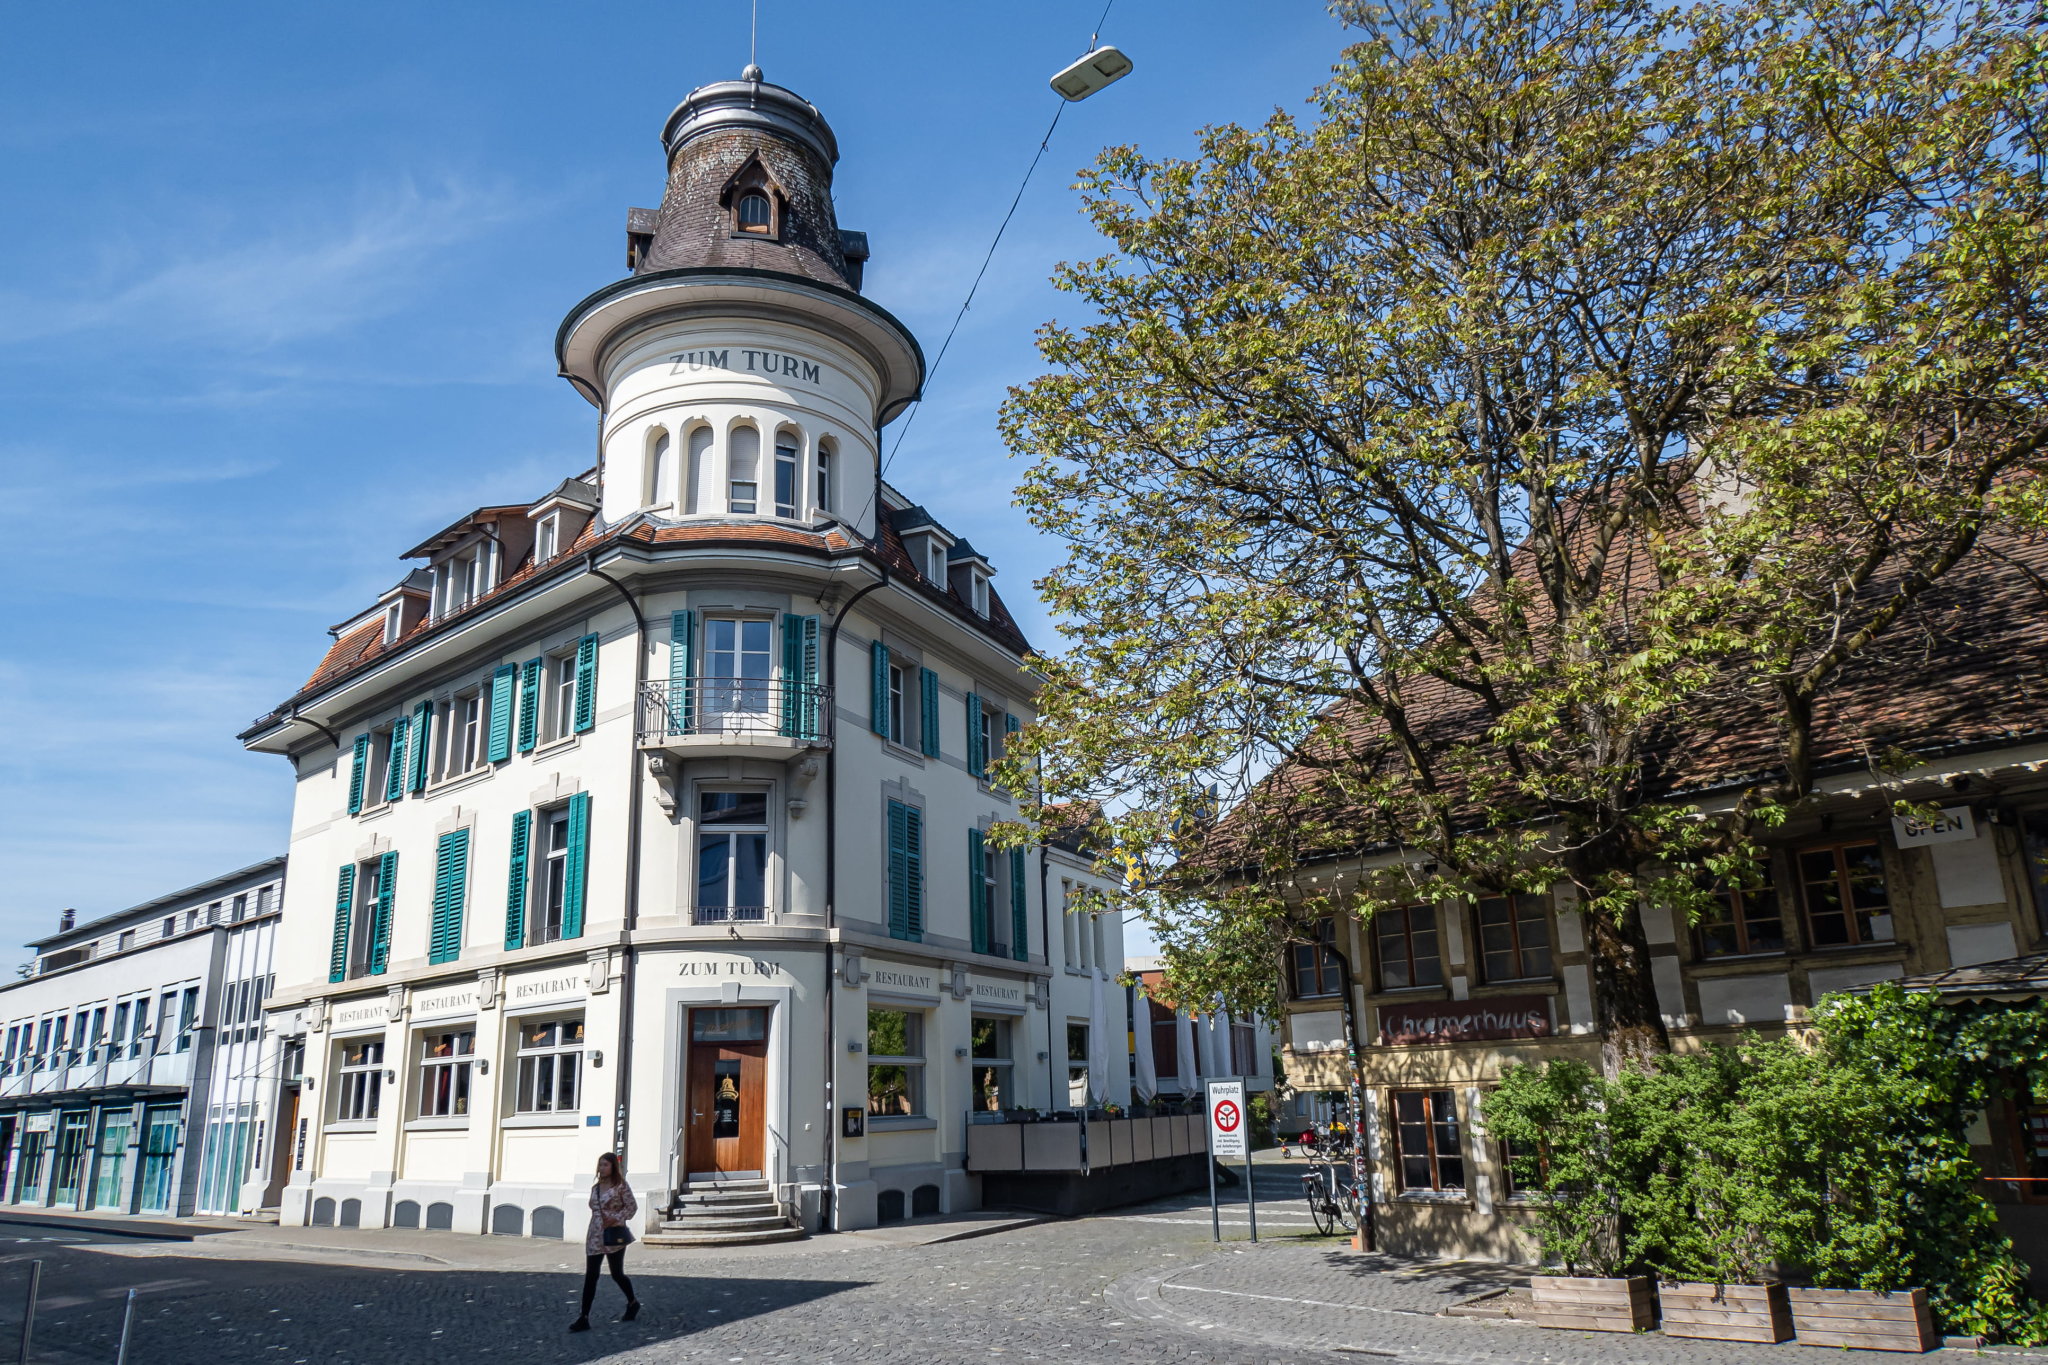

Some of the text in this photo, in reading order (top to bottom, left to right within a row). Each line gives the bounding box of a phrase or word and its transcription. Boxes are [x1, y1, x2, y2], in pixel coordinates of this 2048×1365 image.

[669, 350, 820, 385] ZUM TURM
[679, 962, 781, 976] ZUM TURM
[516, 977, 578, 998] RESTAURANT
[875, 971, 931, 989] RESTAURANT
[976, 984, 1019, 1000] RESTAURANT
[420, 993, 472, 1012] RESTAURANT
[339, 1006, 383, 1023] RESTAURANT
[1212, 1085, 1239, 1096] Wuhrplatz
